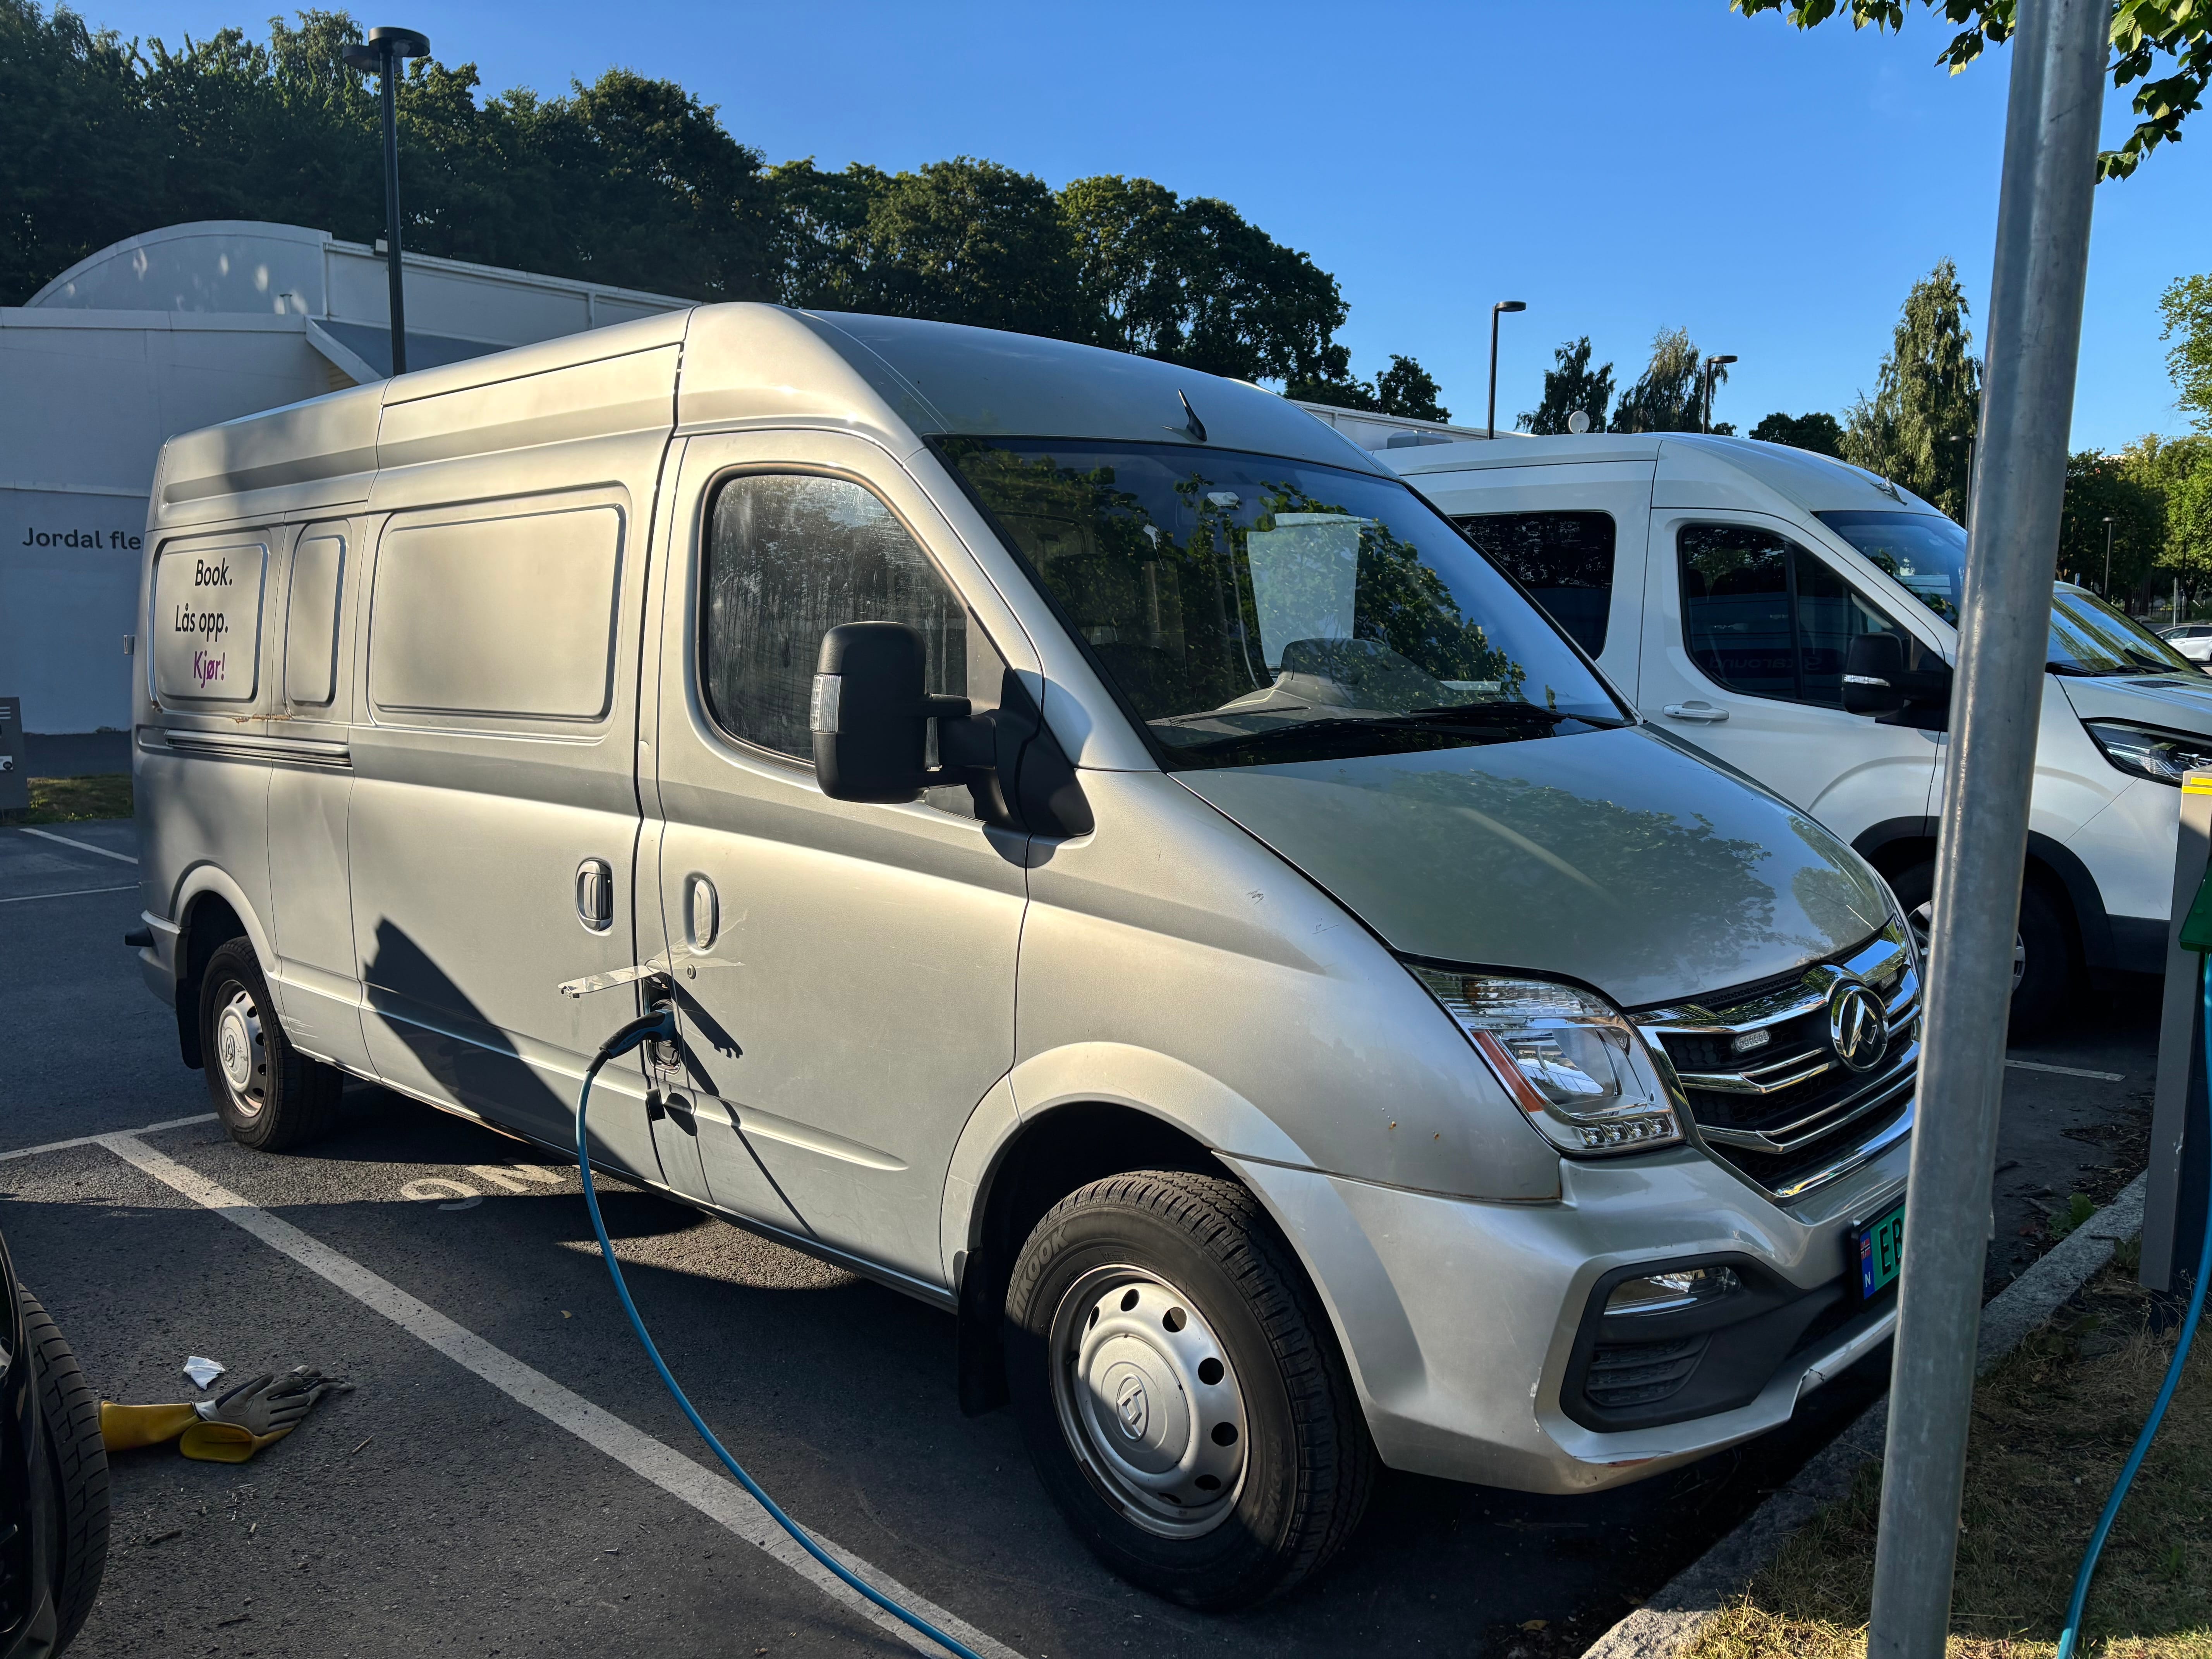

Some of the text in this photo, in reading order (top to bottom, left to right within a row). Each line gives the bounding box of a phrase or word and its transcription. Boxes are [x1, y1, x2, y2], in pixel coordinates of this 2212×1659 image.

[22, 527, 141, 550] Jordal fle
[195, 557, 232, 586] Book.
[175, 603, 228, 642] Lås opp.
[194, 650, 225, 688] Kjør!
[400, 1157, 598, 1211] NG
[1865, 1271, 1871, 1288] N
